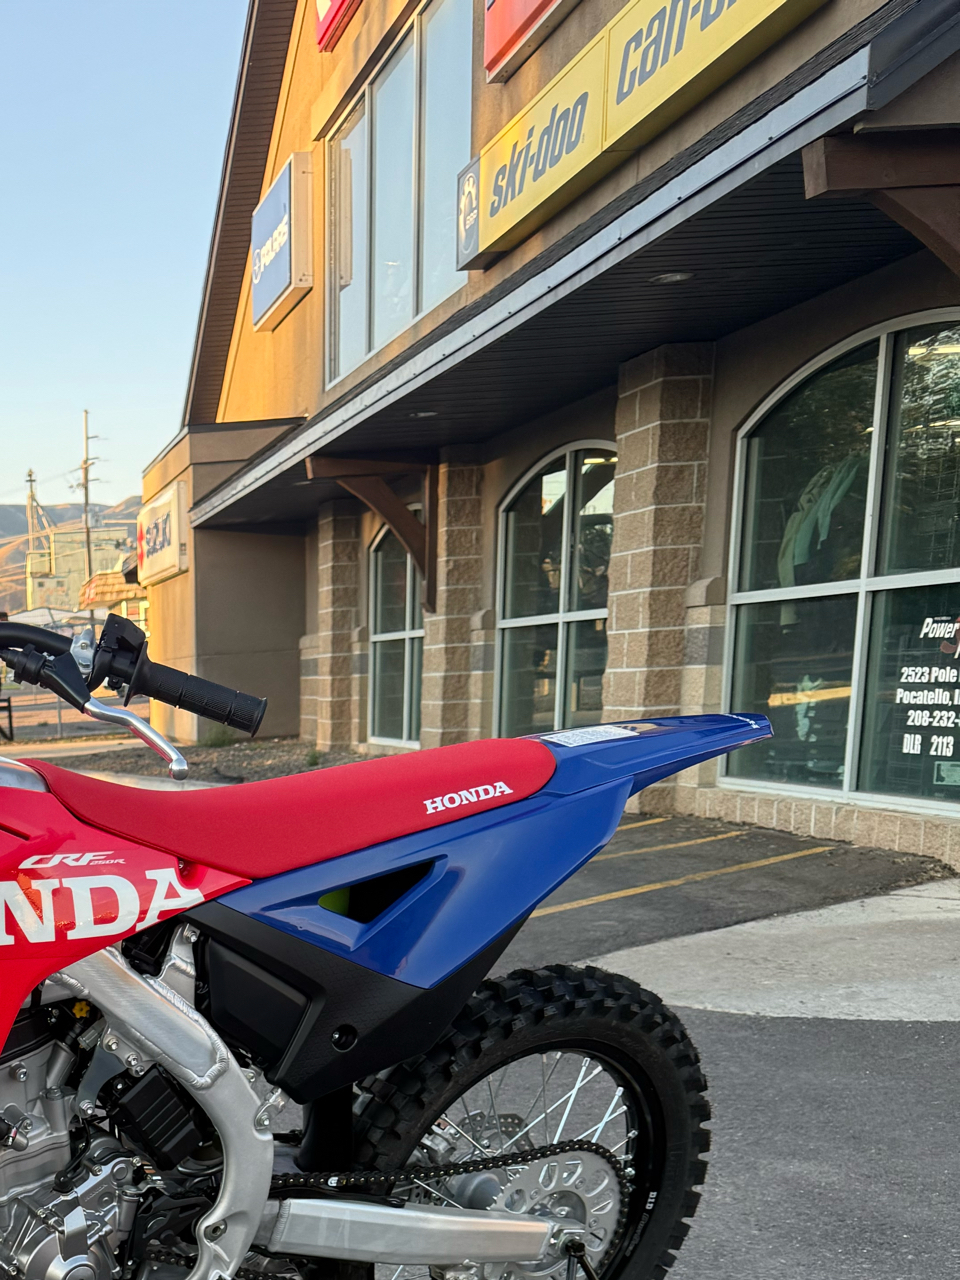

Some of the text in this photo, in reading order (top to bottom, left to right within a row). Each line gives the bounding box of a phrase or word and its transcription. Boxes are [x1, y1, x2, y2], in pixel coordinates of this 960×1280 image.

[616, 0, 738, 105] can-
[490, 91, 589, 218] ski-doo
[919, 617, 960, 639] Power
[900, 666, 958, 683] 2523 Pole
[895, 688, 953, 706] Pocatello,
[906, 709, 960, 728] 208-232-
[902, 733, 955, 757] DLR 2113
[423, 781, 514, 815] HONDA
[18, 851, 115, 869] CRF
